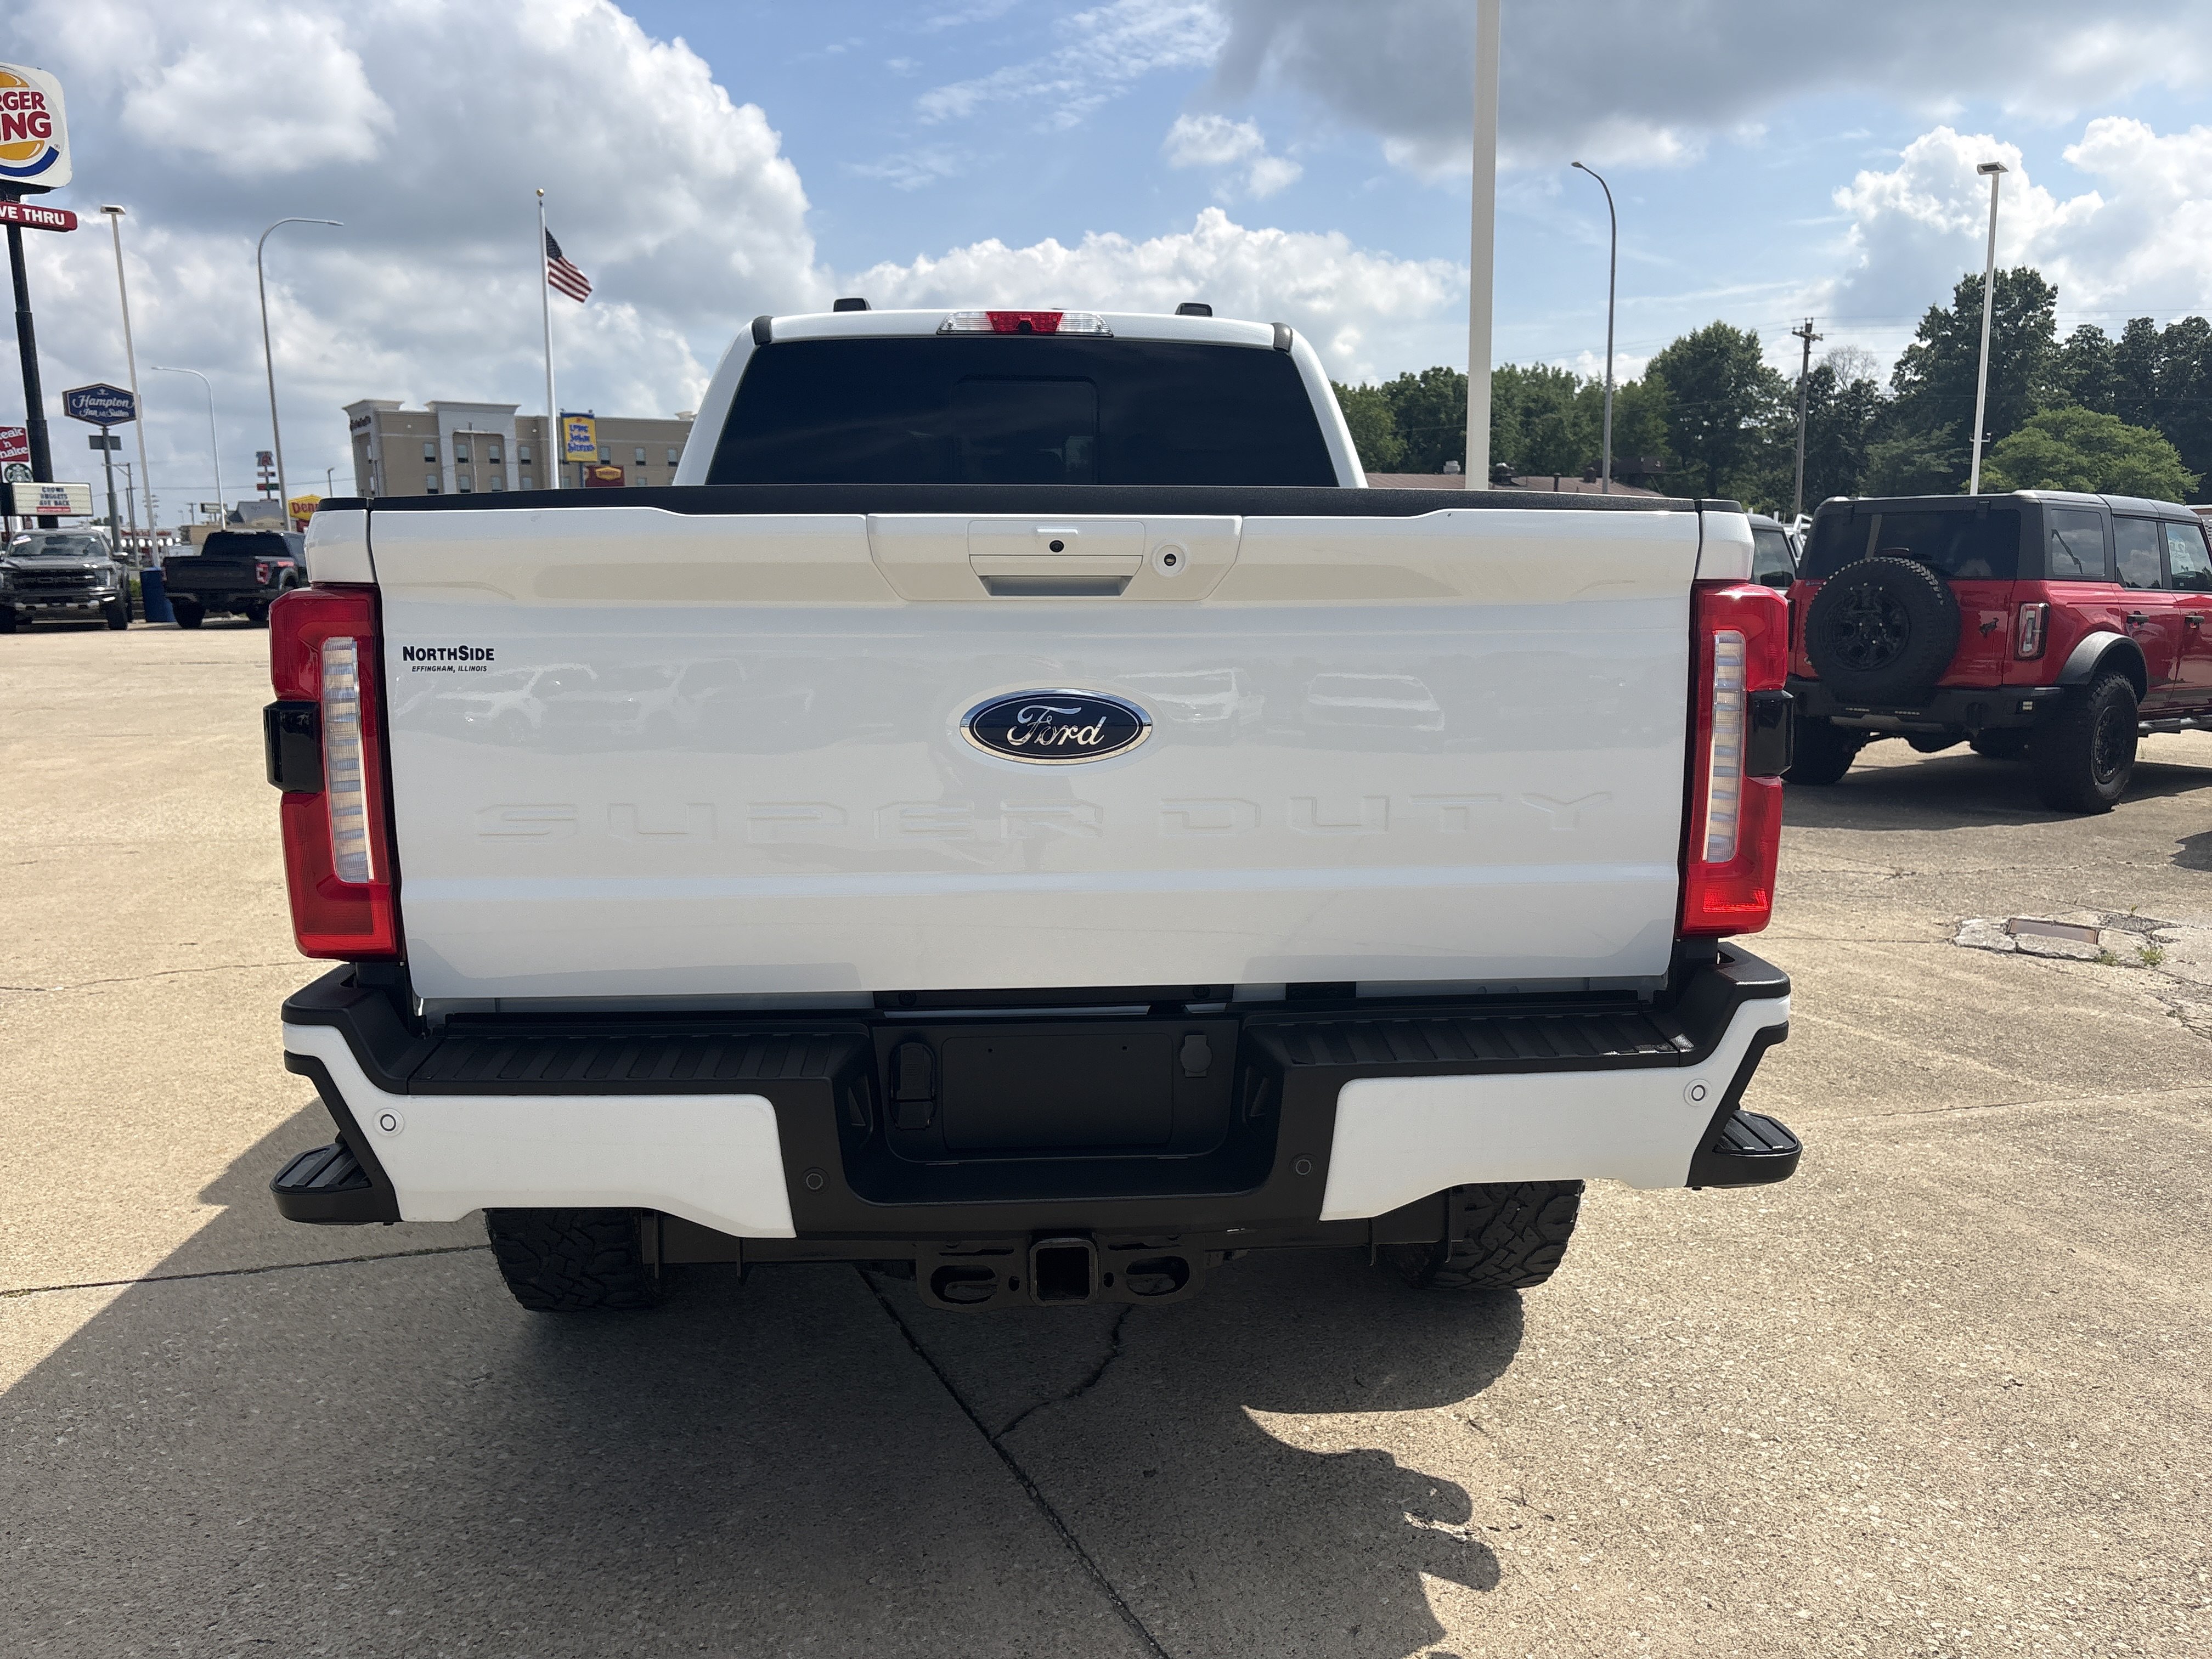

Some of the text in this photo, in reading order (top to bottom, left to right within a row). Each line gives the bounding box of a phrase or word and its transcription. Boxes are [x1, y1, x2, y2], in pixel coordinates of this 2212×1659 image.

[0, 91, 46, 111] GER
[0, 111, 52, 141] NG
[22, 208, 65, 225] THRU
[72, 394, 134, 409] Hampton
[1007, 704, 1107, 746] Ford
[475, 792, 1612, 845] SUPER DUTY
